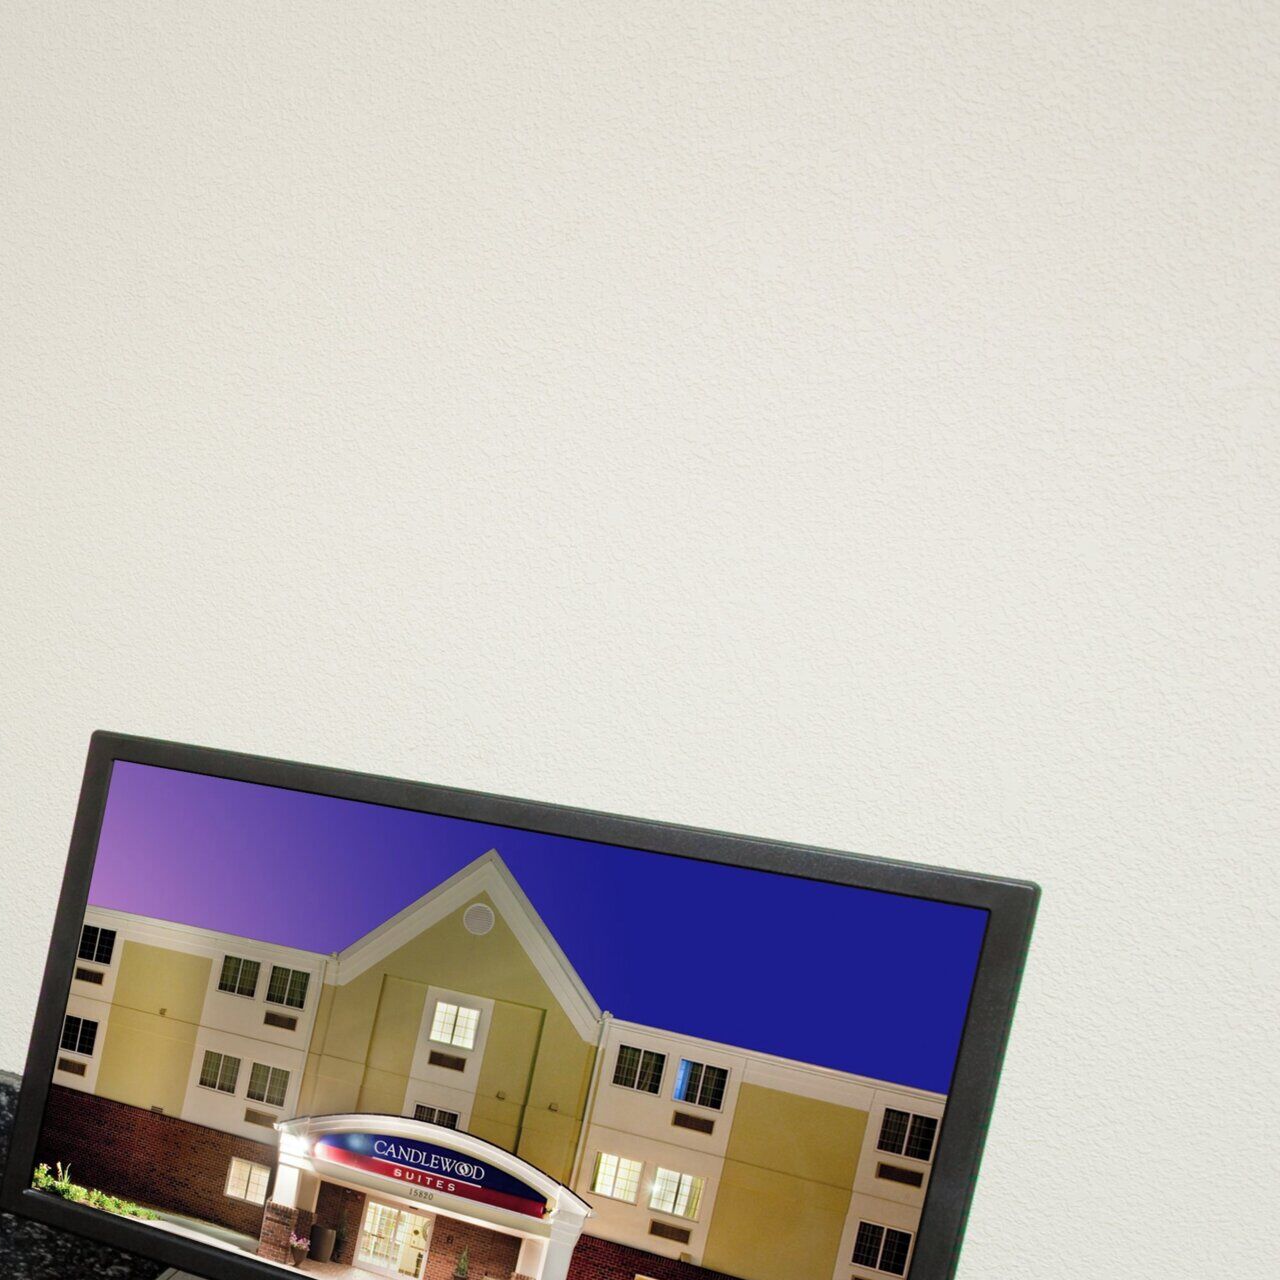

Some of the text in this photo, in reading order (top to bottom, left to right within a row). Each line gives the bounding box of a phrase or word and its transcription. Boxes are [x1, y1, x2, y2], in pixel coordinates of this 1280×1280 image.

[373, 1139, 486, 1181] CANDLEWOOD
[393, 1168, 457, 1192] SUITES
[409, 1187, 434, 1201] 15820
